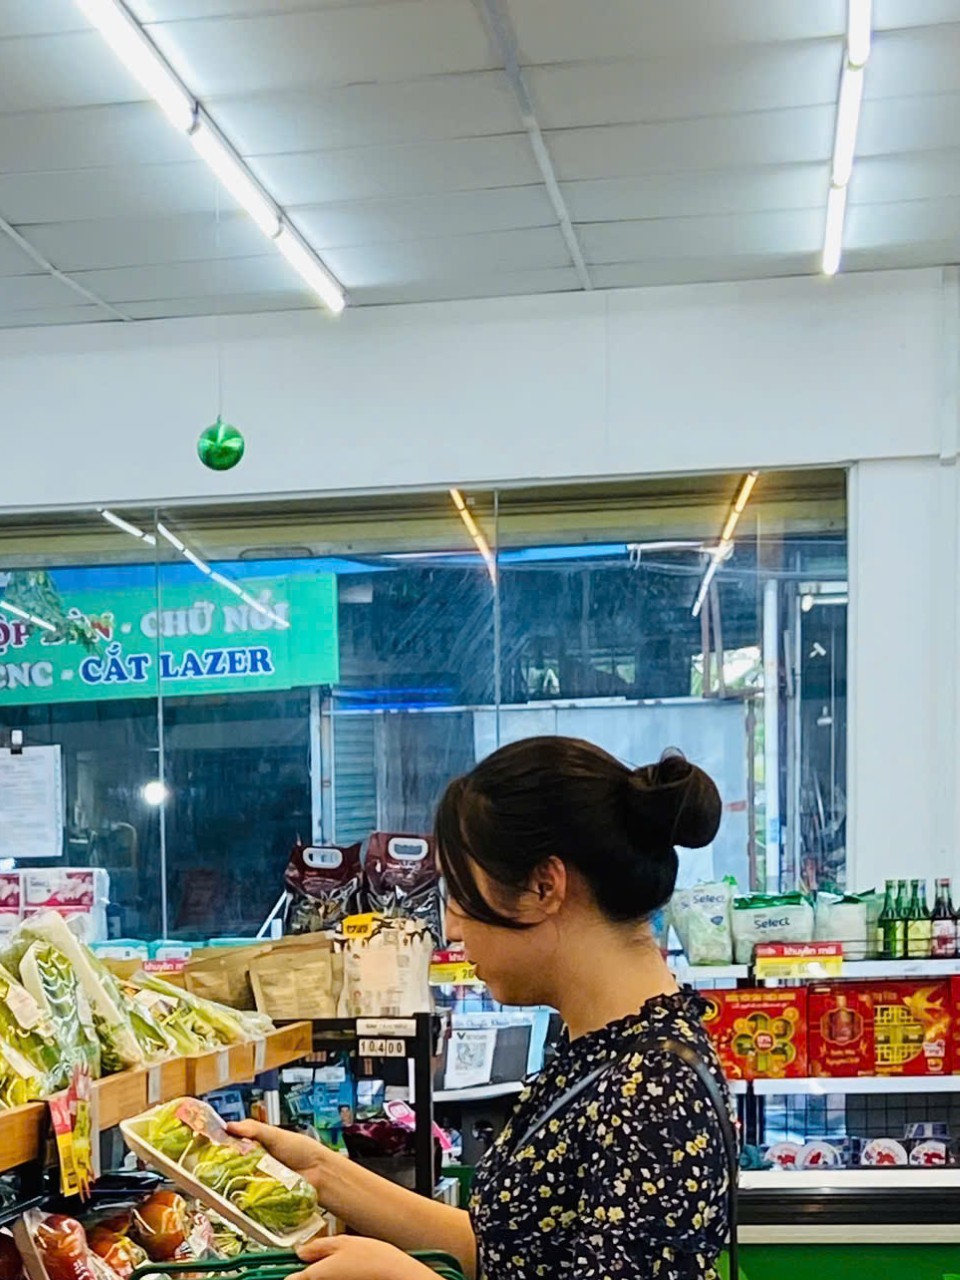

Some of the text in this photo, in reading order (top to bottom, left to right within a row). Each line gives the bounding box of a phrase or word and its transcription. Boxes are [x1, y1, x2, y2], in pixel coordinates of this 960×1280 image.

[141, 601, 214, 638] CHỮ
[79, 643, 151, 685] CẮT
[159, 646, 275, 682] LAZER
[753, 917, 791, 930] Select
